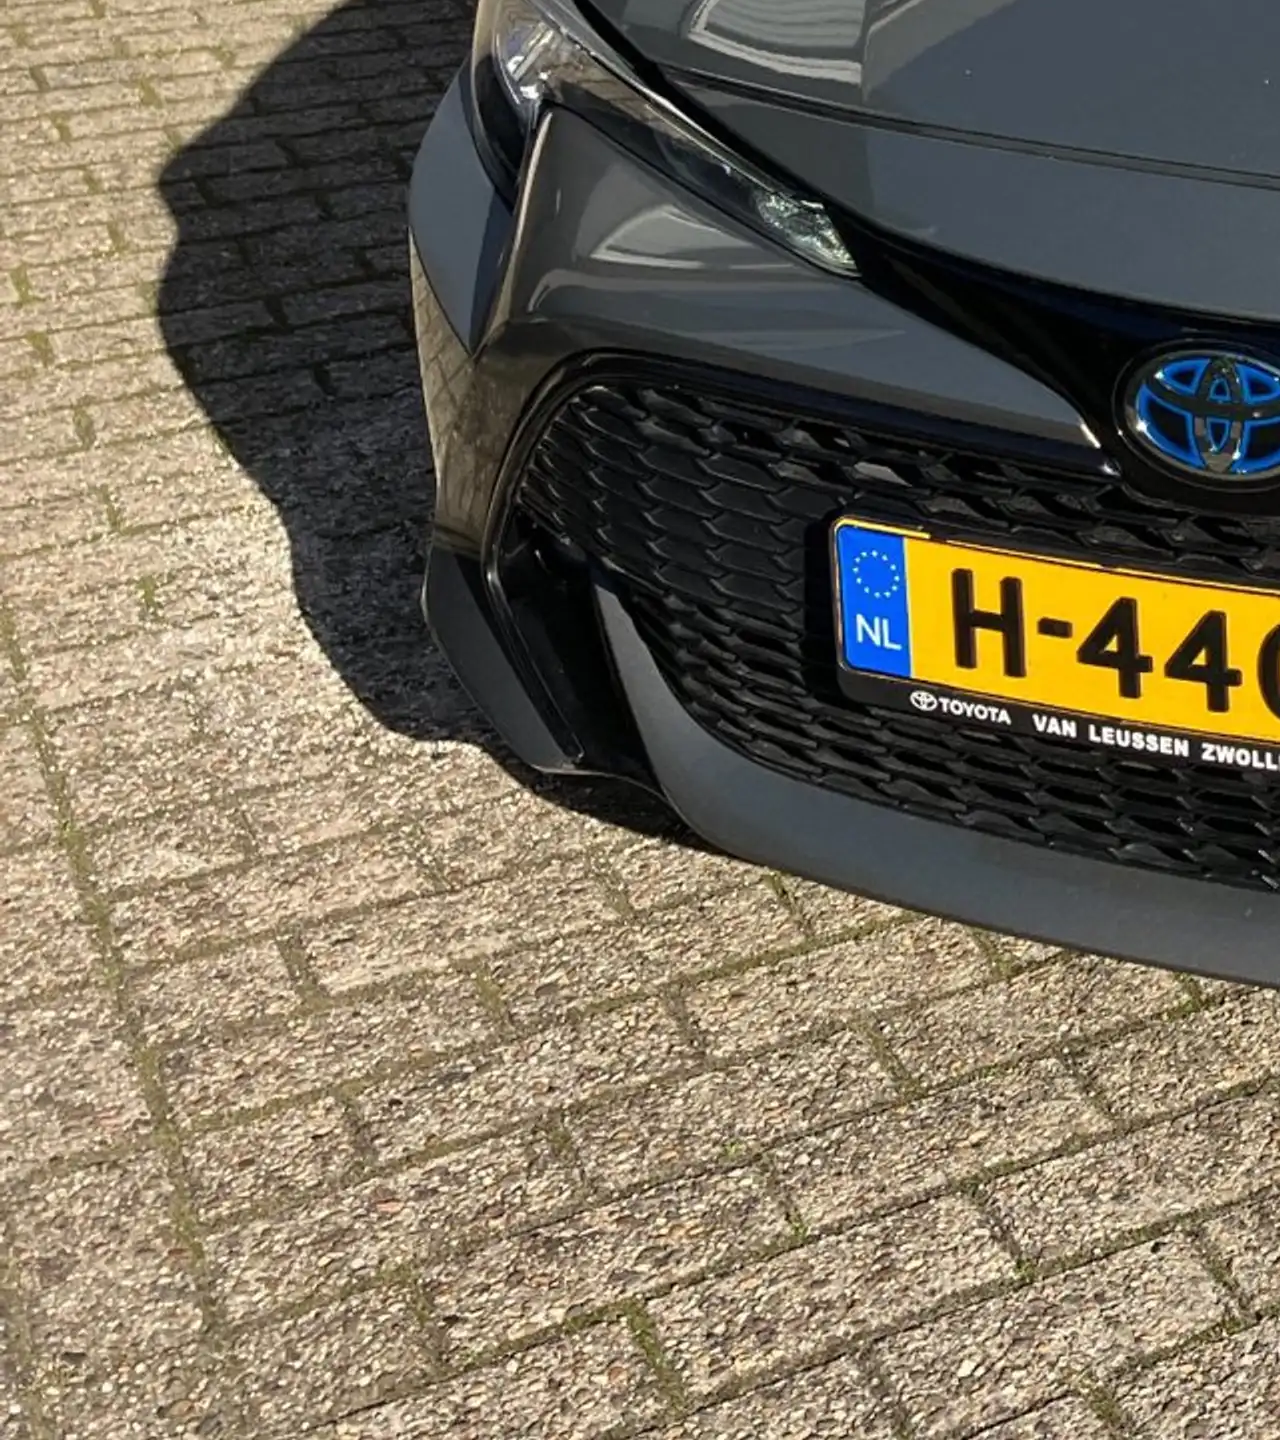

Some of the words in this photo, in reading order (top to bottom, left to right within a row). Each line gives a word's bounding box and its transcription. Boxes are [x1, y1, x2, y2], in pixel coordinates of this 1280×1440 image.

[856, 613, 902, 651] NL
[938, 697, 1012, 725] TOYOTA
[1032, 713, 1077, 738] VAN
[1088, 724, 1190, 757] LEUSSEN
